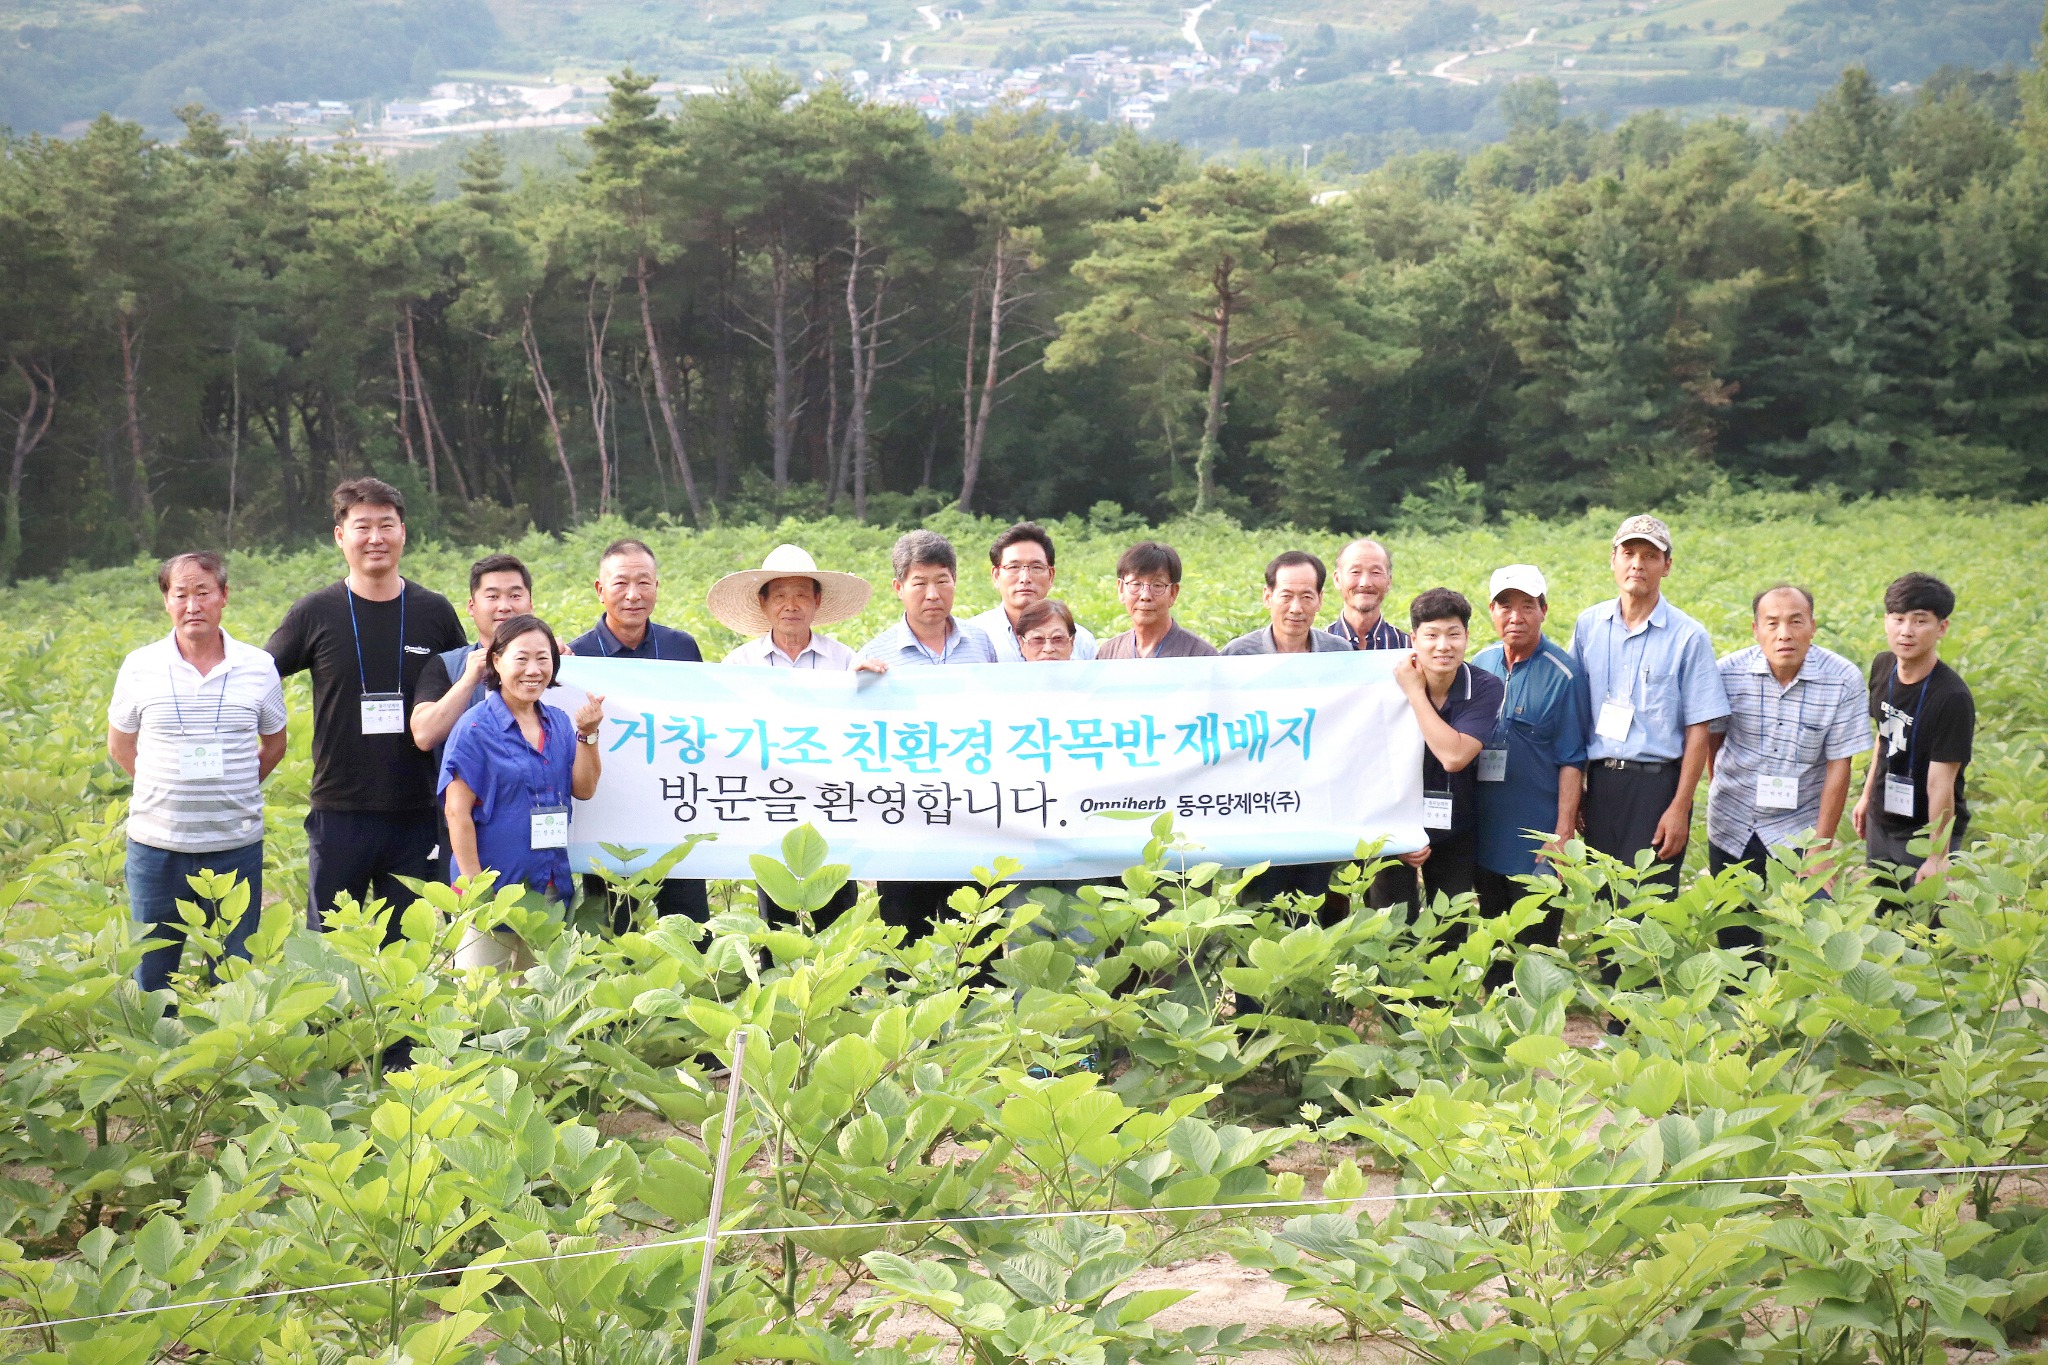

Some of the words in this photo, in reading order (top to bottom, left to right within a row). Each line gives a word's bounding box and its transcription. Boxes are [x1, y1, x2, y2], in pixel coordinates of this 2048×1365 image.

[608, 712, 717, 765] 거창
[724, 718, 832, 771] 가조
[842, 719, 992, 775] 친환경
[1007, 714, 1166, 773] 작목반
[1174, 707, 1317, 766] 재배지
[659, 772, 807, 823] 방문을
[813, 780, 1067, 829] 환영합니다.
[1080, 796, 1167, 813] Omniherb
[1176, 790, 1301, 817] 동우당제약(주)
